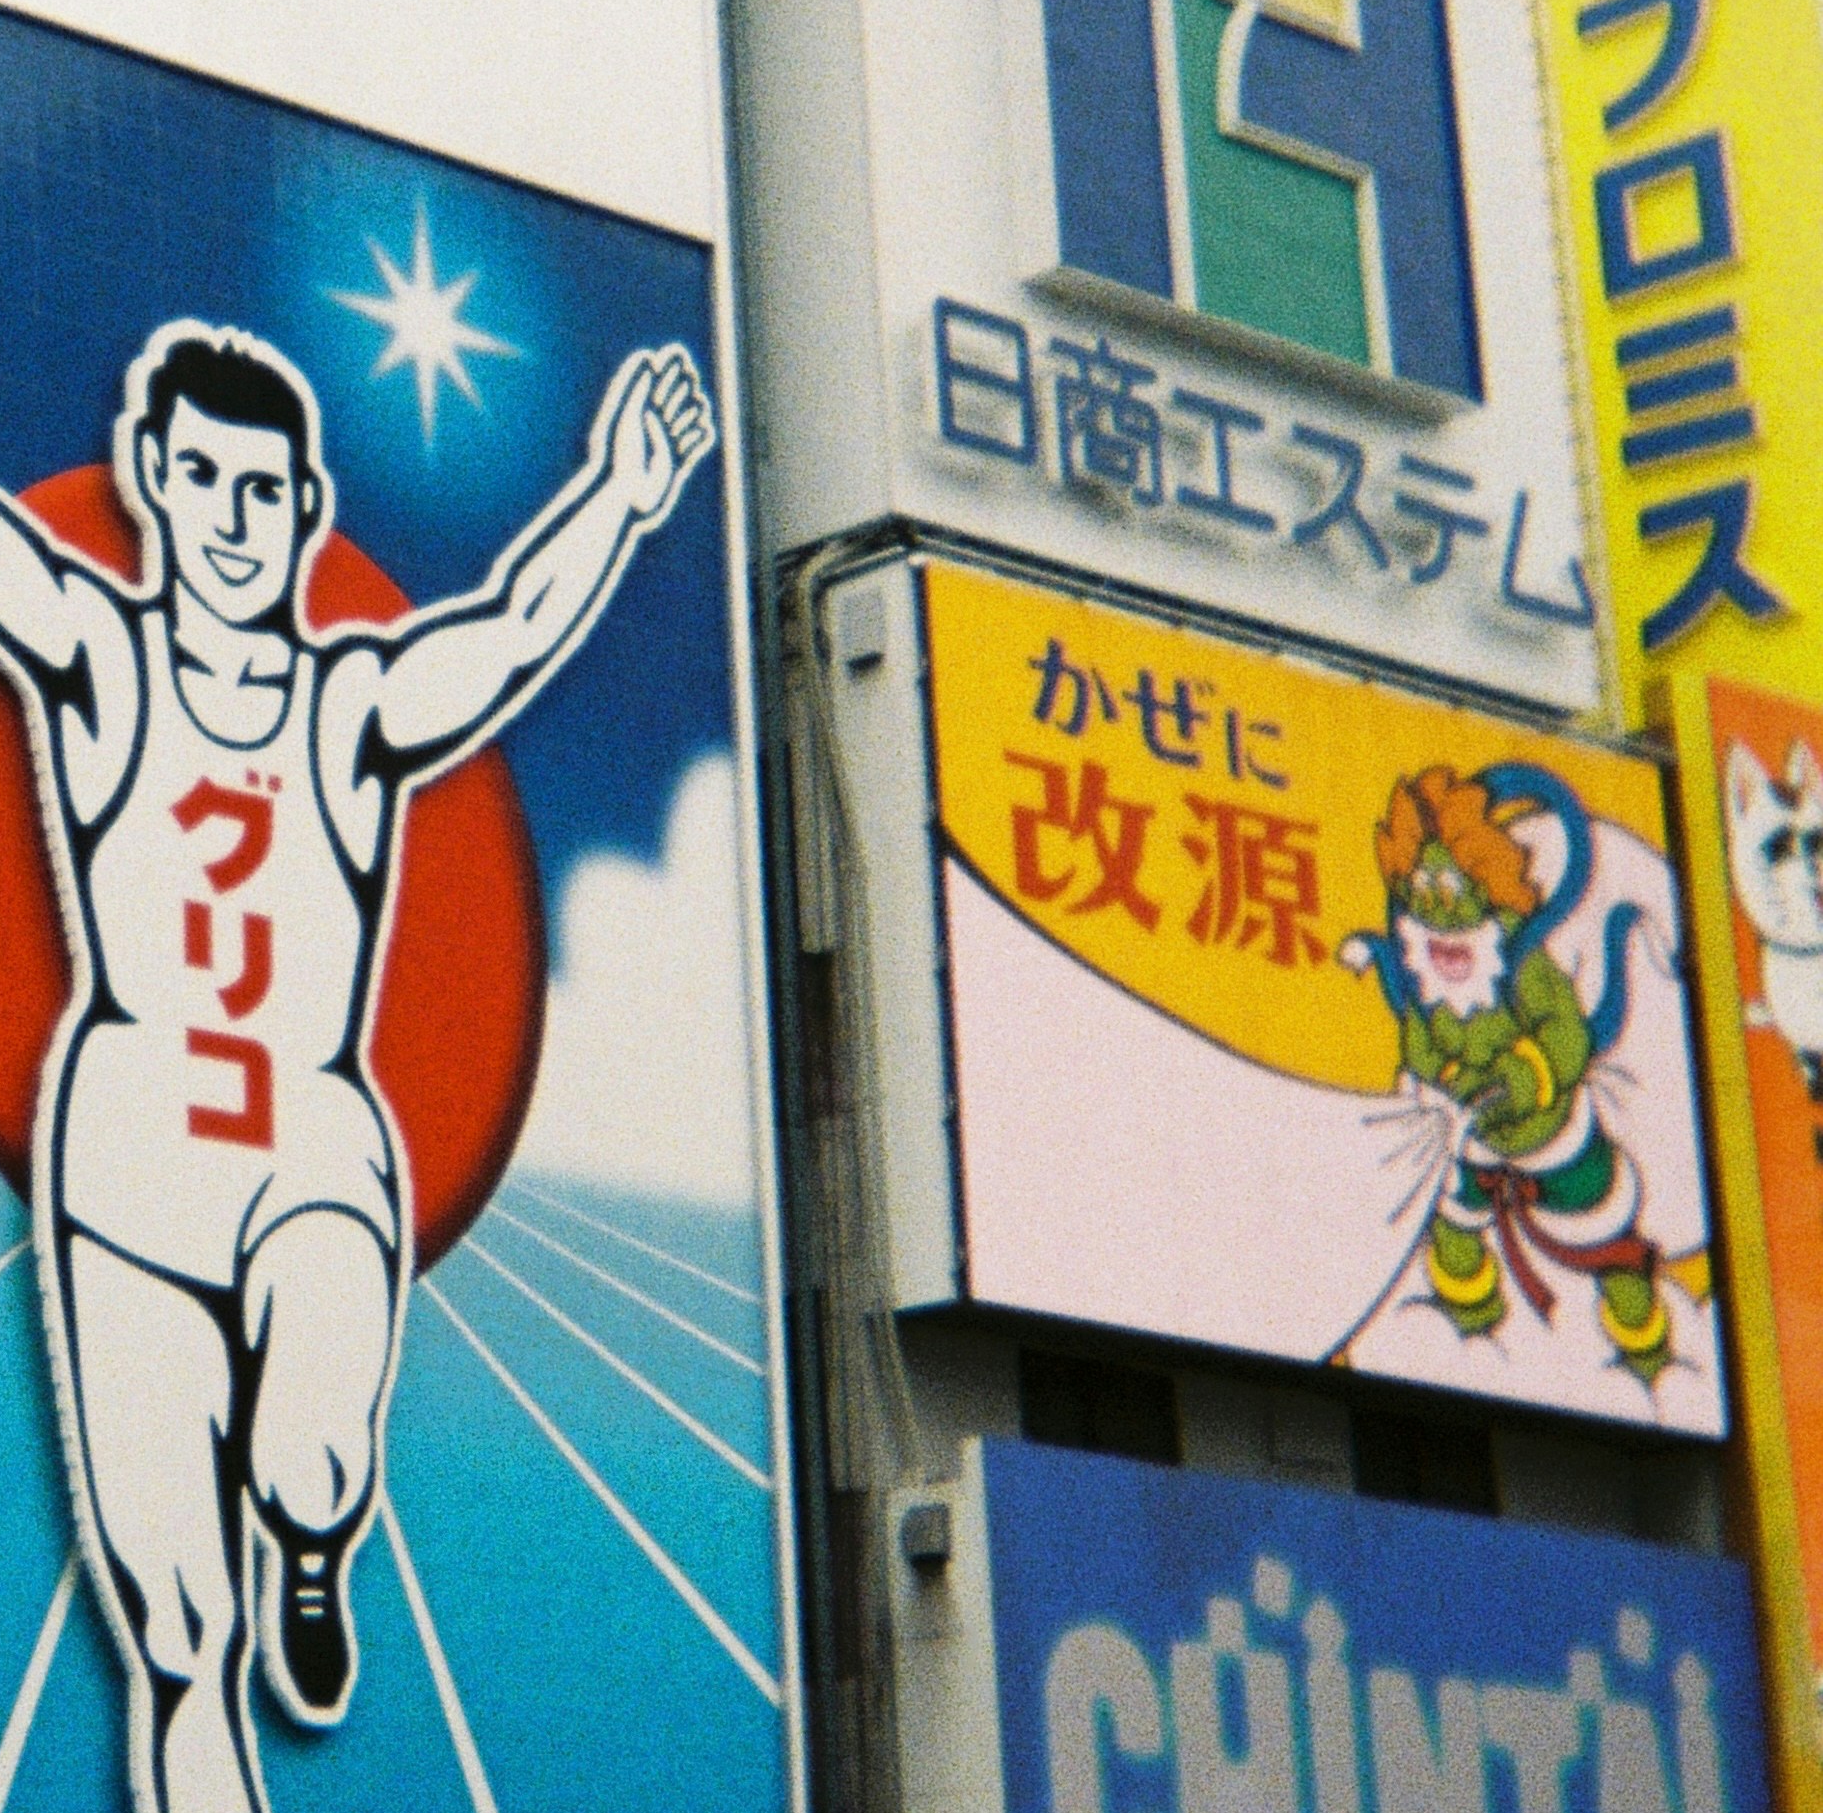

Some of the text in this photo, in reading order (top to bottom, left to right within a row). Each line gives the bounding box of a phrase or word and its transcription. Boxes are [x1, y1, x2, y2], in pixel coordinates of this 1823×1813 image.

[933, 294, 1598, 631] 日商エステム
[1027, 636, 1292, 791] かぜに
[169, 767, 283, 1151] グリコ
[1001, 747, 1328, 972] 改源
